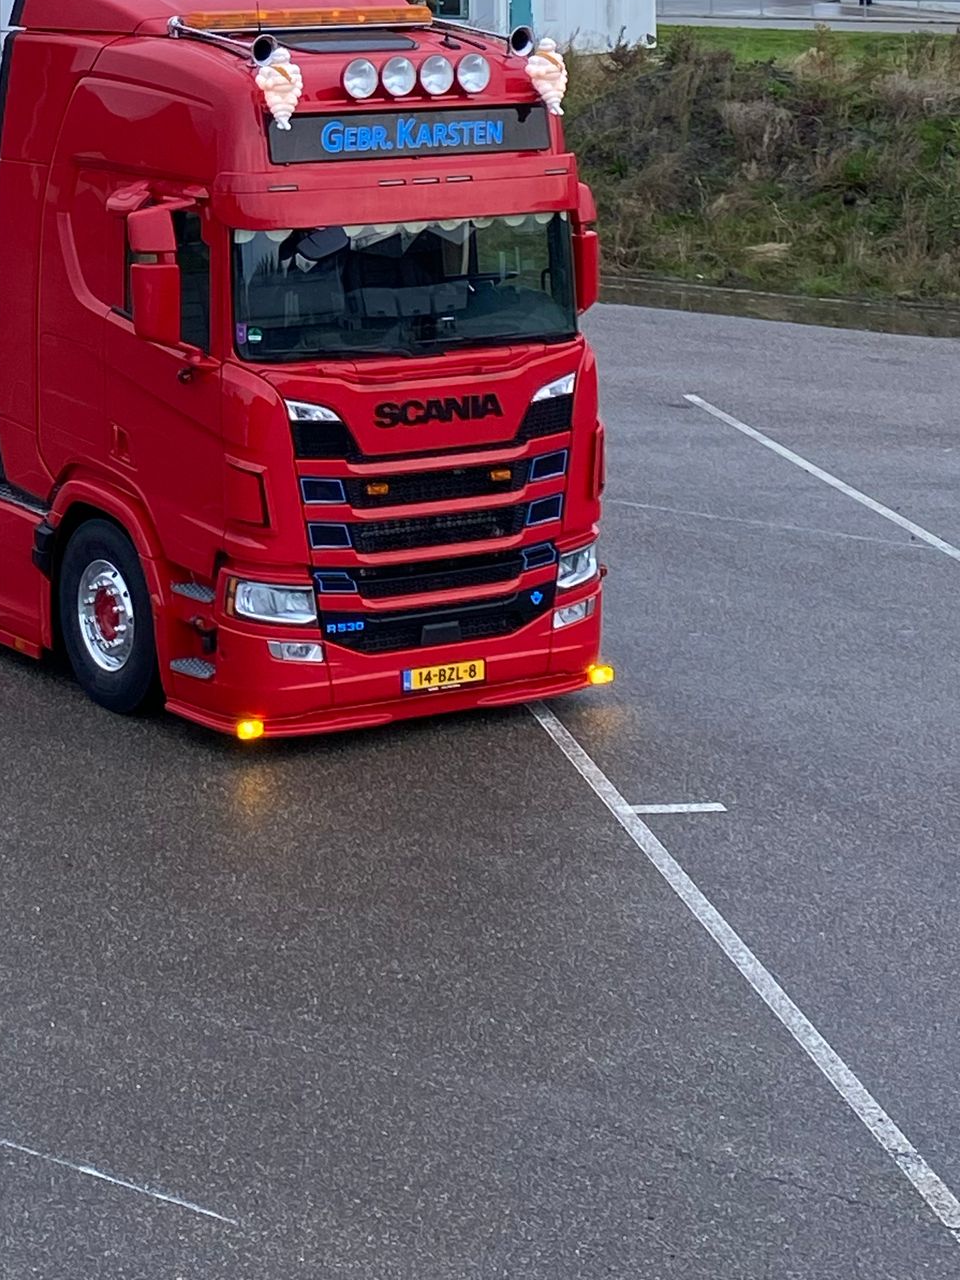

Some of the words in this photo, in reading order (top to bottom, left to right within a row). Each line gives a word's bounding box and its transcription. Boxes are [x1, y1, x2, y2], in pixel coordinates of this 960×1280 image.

[321, 120, 393, 153] GEBR.
[396, 118, 503, 150] KARSTEN
[374, 393, 504, 429] SCANIA
[326, 621, 365, 634] R530
[418, 663, 477, 686] 14-BZL-8
